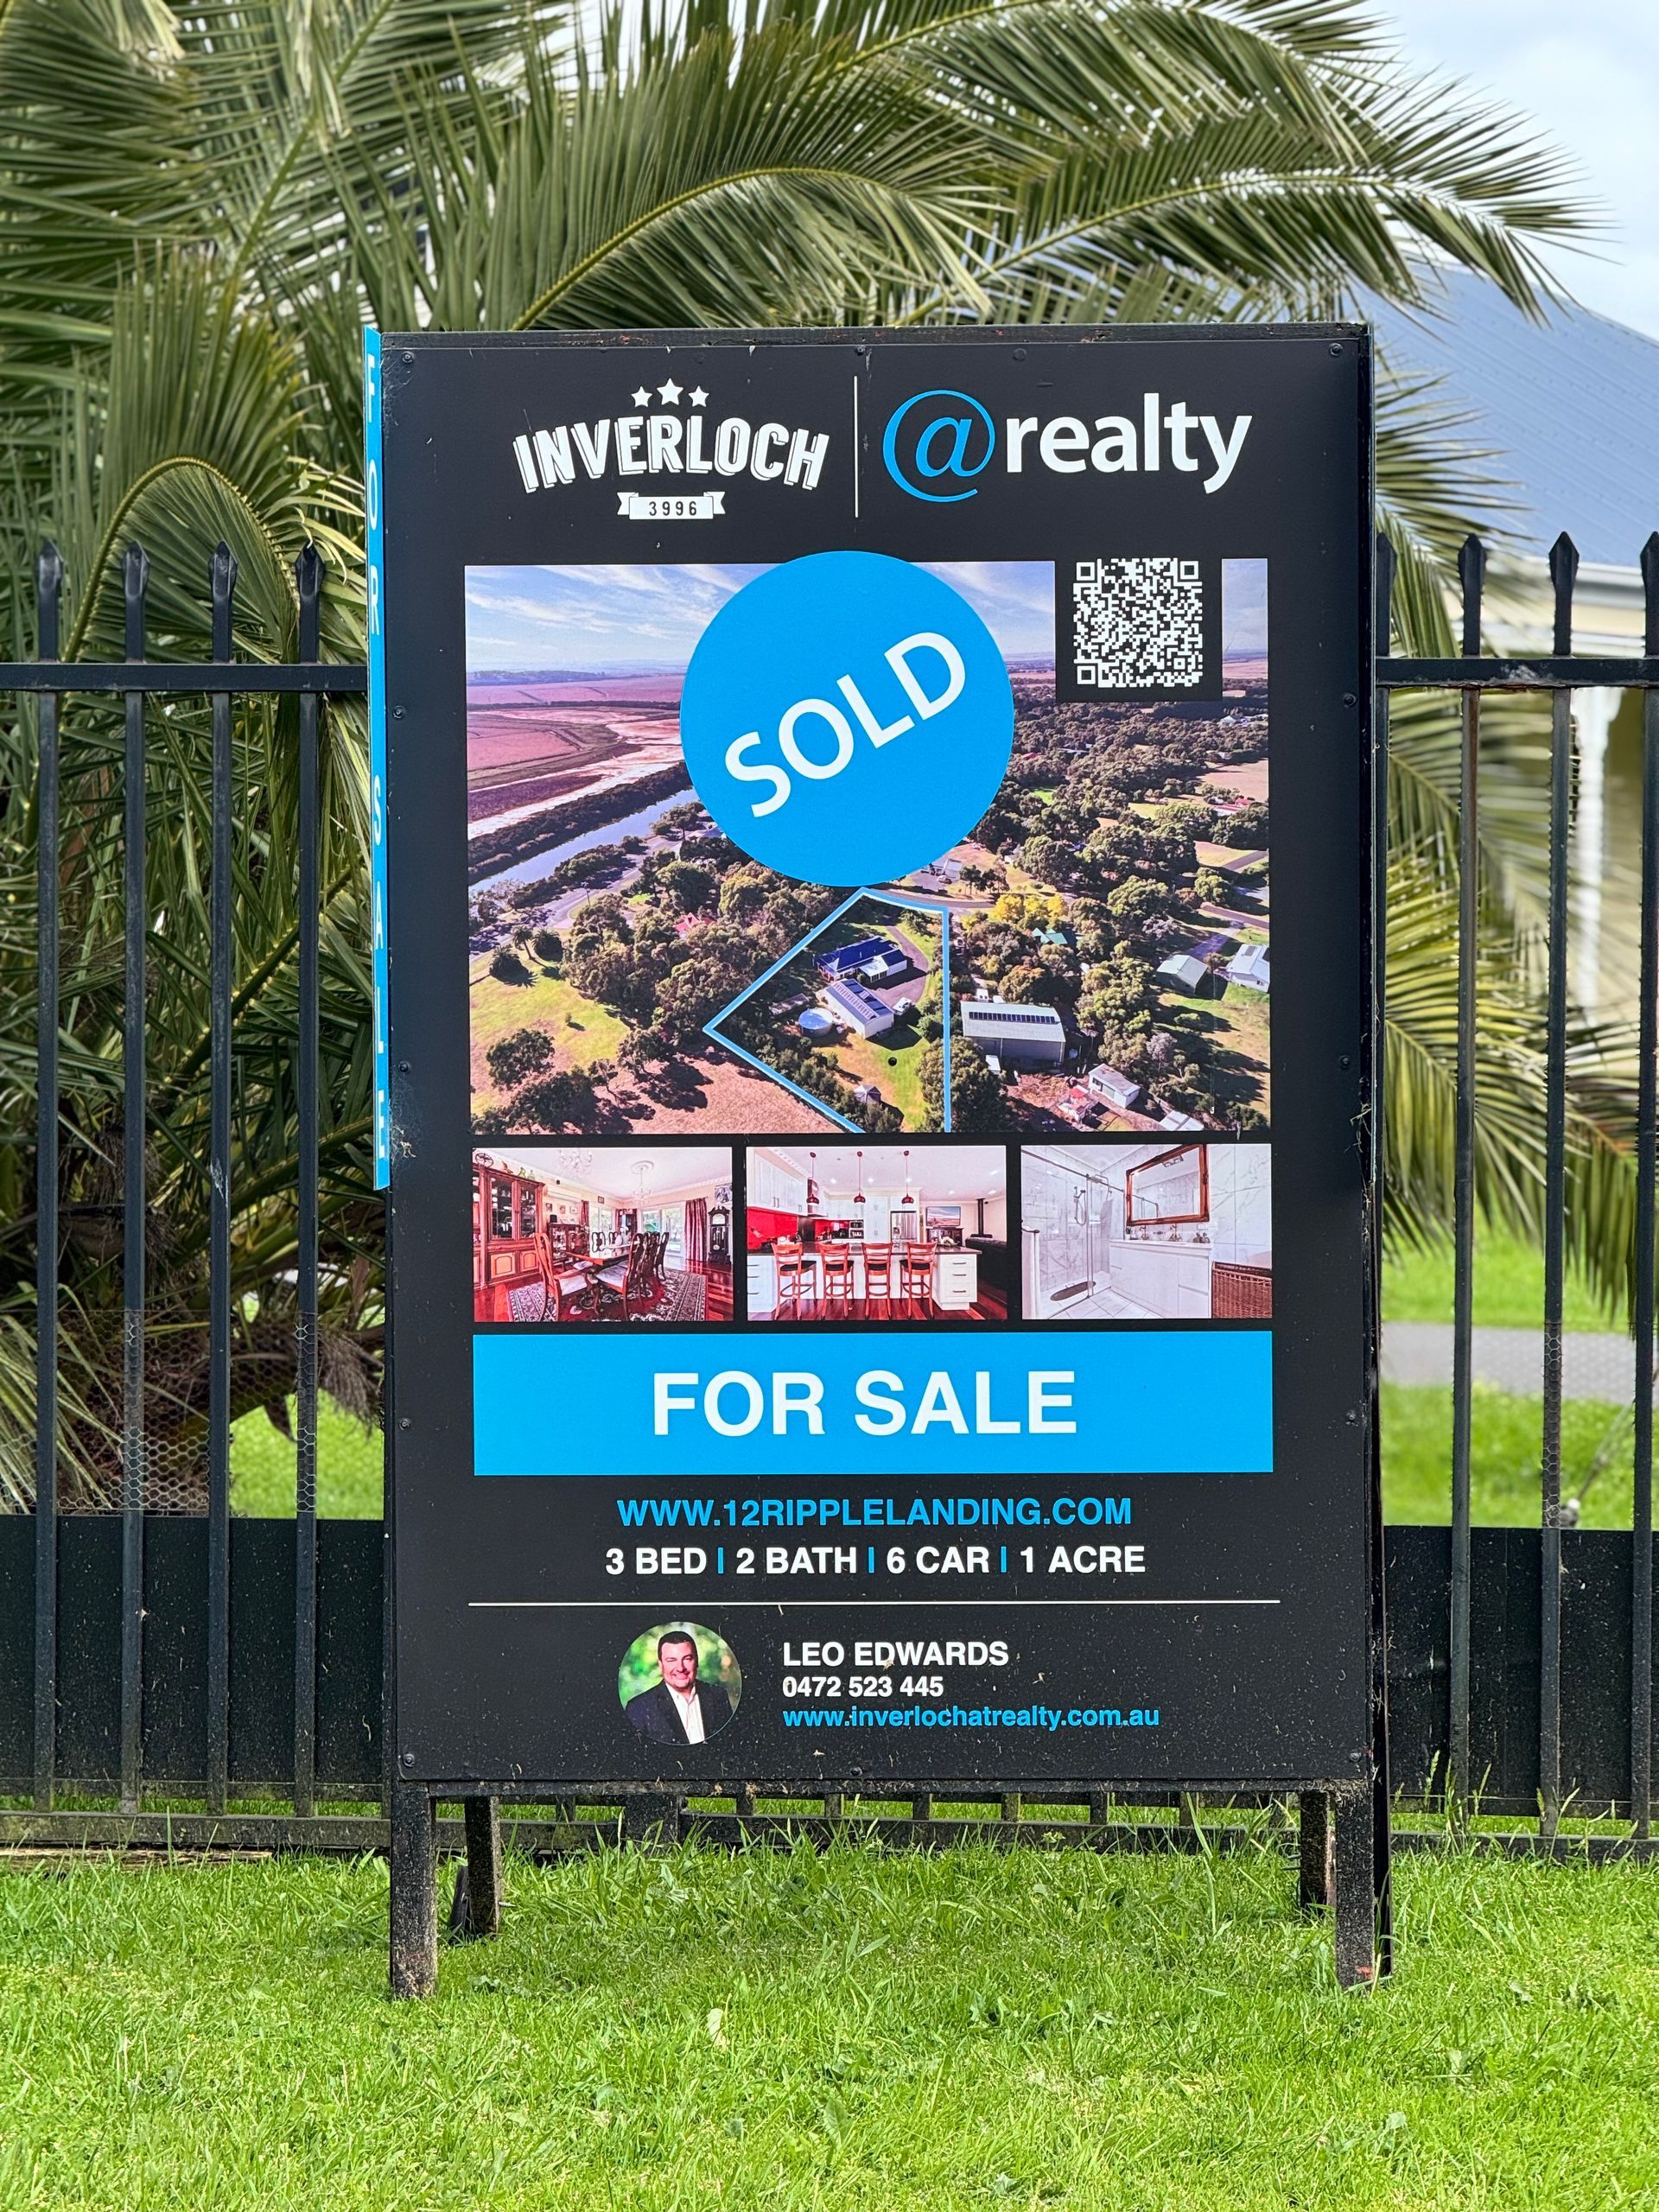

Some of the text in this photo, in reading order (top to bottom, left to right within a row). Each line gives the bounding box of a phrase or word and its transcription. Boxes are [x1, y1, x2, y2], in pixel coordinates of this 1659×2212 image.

[513, 416, 830, 493] INVERLOCH
[883, 390, 1252, 503] @realty
[648, 500, 697, 516] 3996
[726, 632, 965, 817] SOLD
[368, 354, 385, 1159] FOR SALE
[654, 1370, 1077, 1436] FOR SALE
[617, 1497, 1132, 1528] WWW.12RIPPLELANDING.COM
[606, 1546, 1146, 1574] 3 BED 2 BATH 6 CAR 1 ACRE
[783, 1641, 1009, 1667] LEO EDWARDS
[783, 1675, 944, 1697] 0472 523 445
[783, 1705, 1160, 1730] www.inverlochatrealty.com.au
